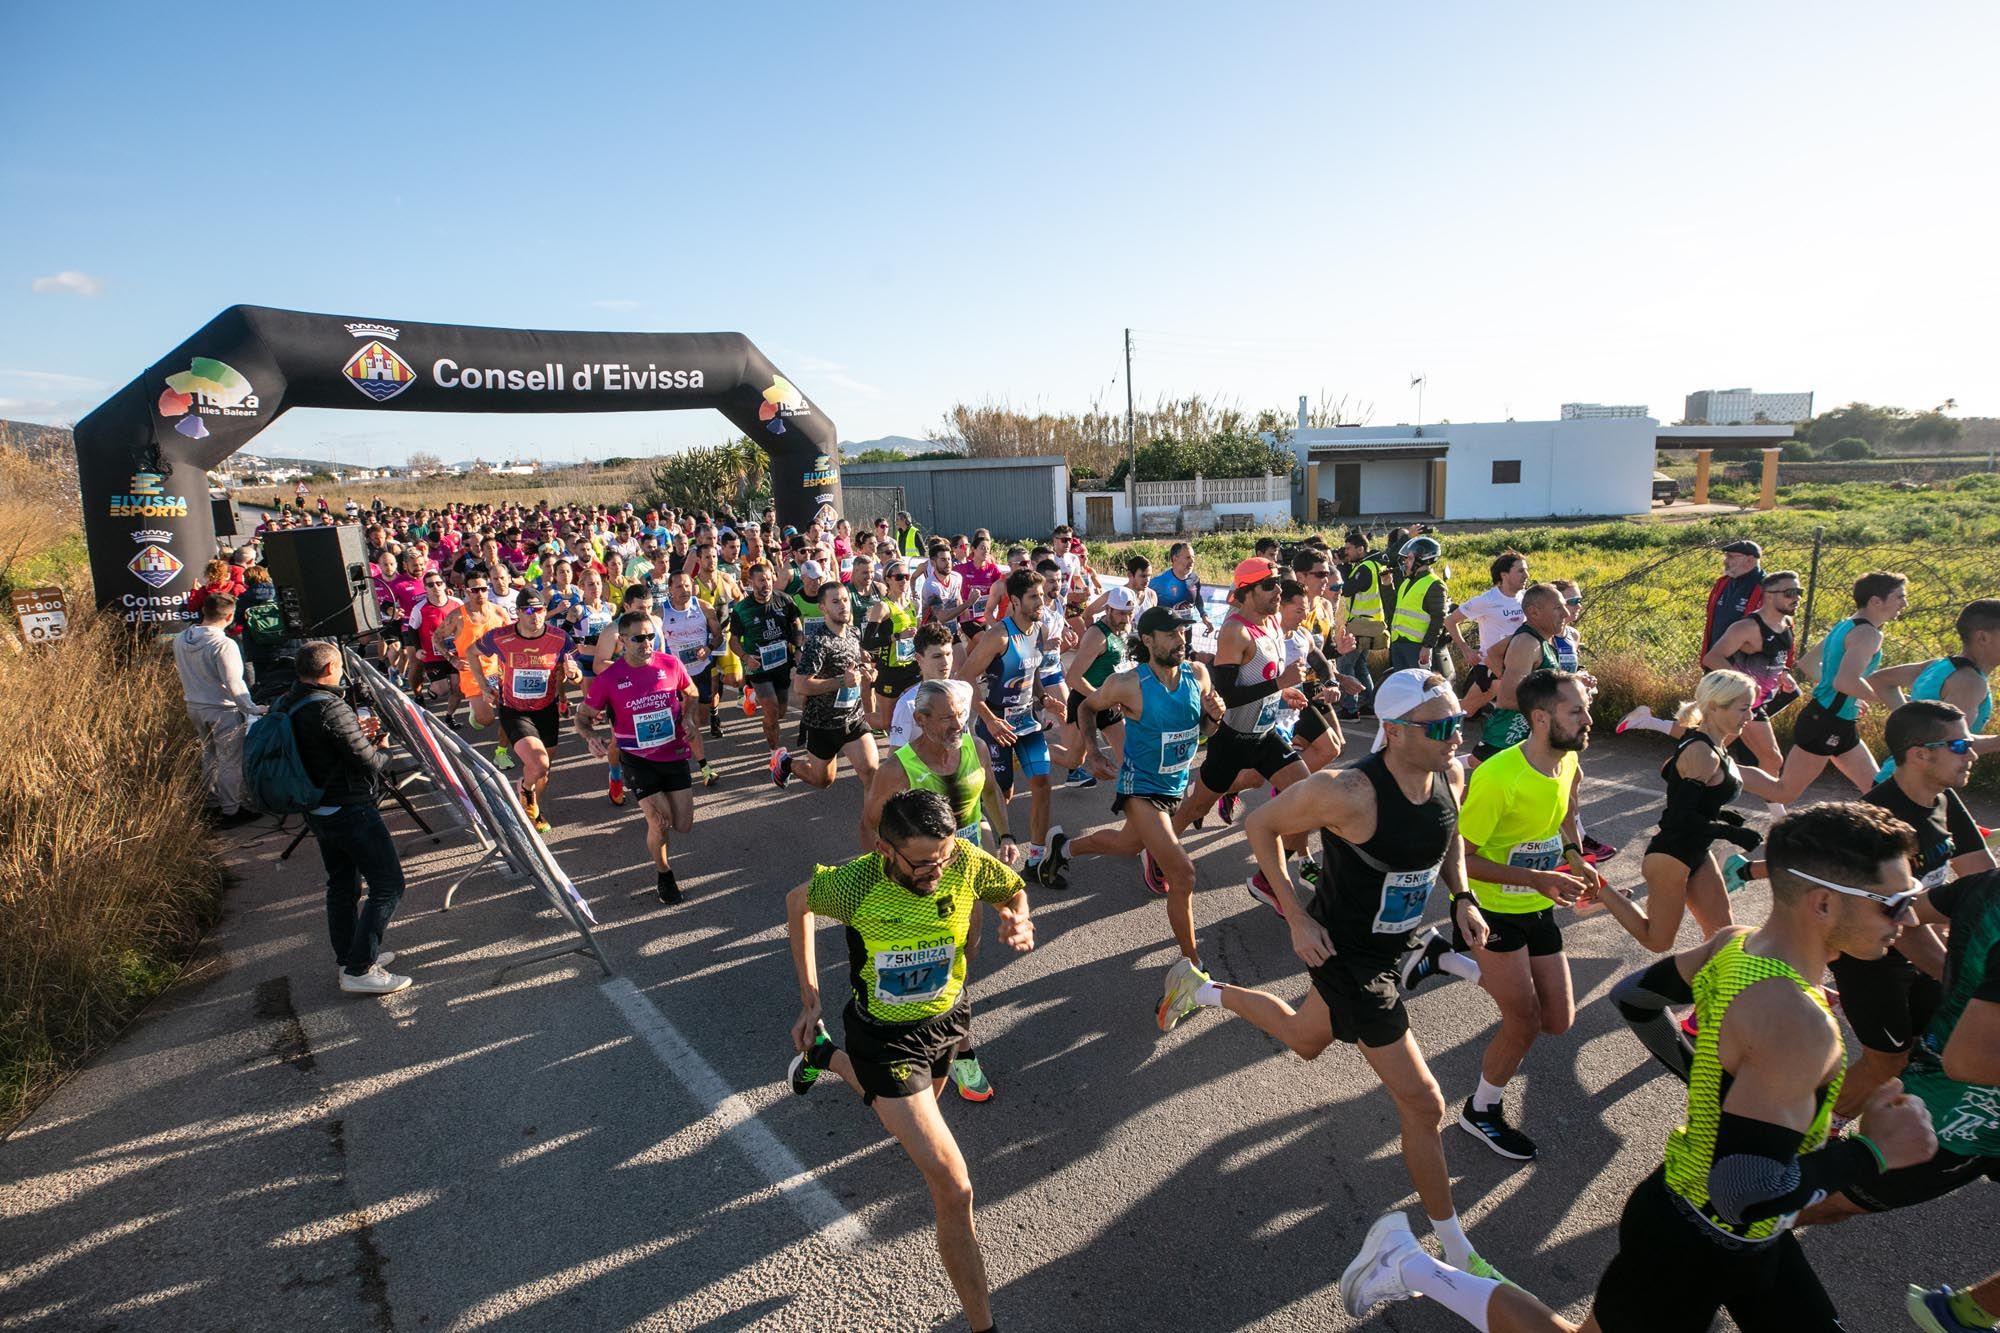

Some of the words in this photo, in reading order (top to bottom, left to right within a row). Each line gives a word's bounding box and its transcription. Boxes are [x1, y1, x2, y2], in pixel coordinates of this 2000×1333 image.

[432, 358, 564, 391] Consell
[572, 363, 705, 391] d'Eivissa
[199, 406, 221, 416] Illes
[223, 408, 258, 417] Balears
[110, 495, 188, 507] EIVISSA
[110, 505, 188, 517] ESPORTS
[16, 600, 62, 614] EI-900
[523, 679, 540, 688] 125
[625, 692, 671, 708] CAMPIONAT
[654, 700, 667, 709] 5K
[648, 722, 662, 734] 92
[1175, 743, 1192, 757] 187
[918, 935, 955, 950] Rota
[895, 947, 947, 964] 5KIBIZA
[897, 967, 933, 986] 117
